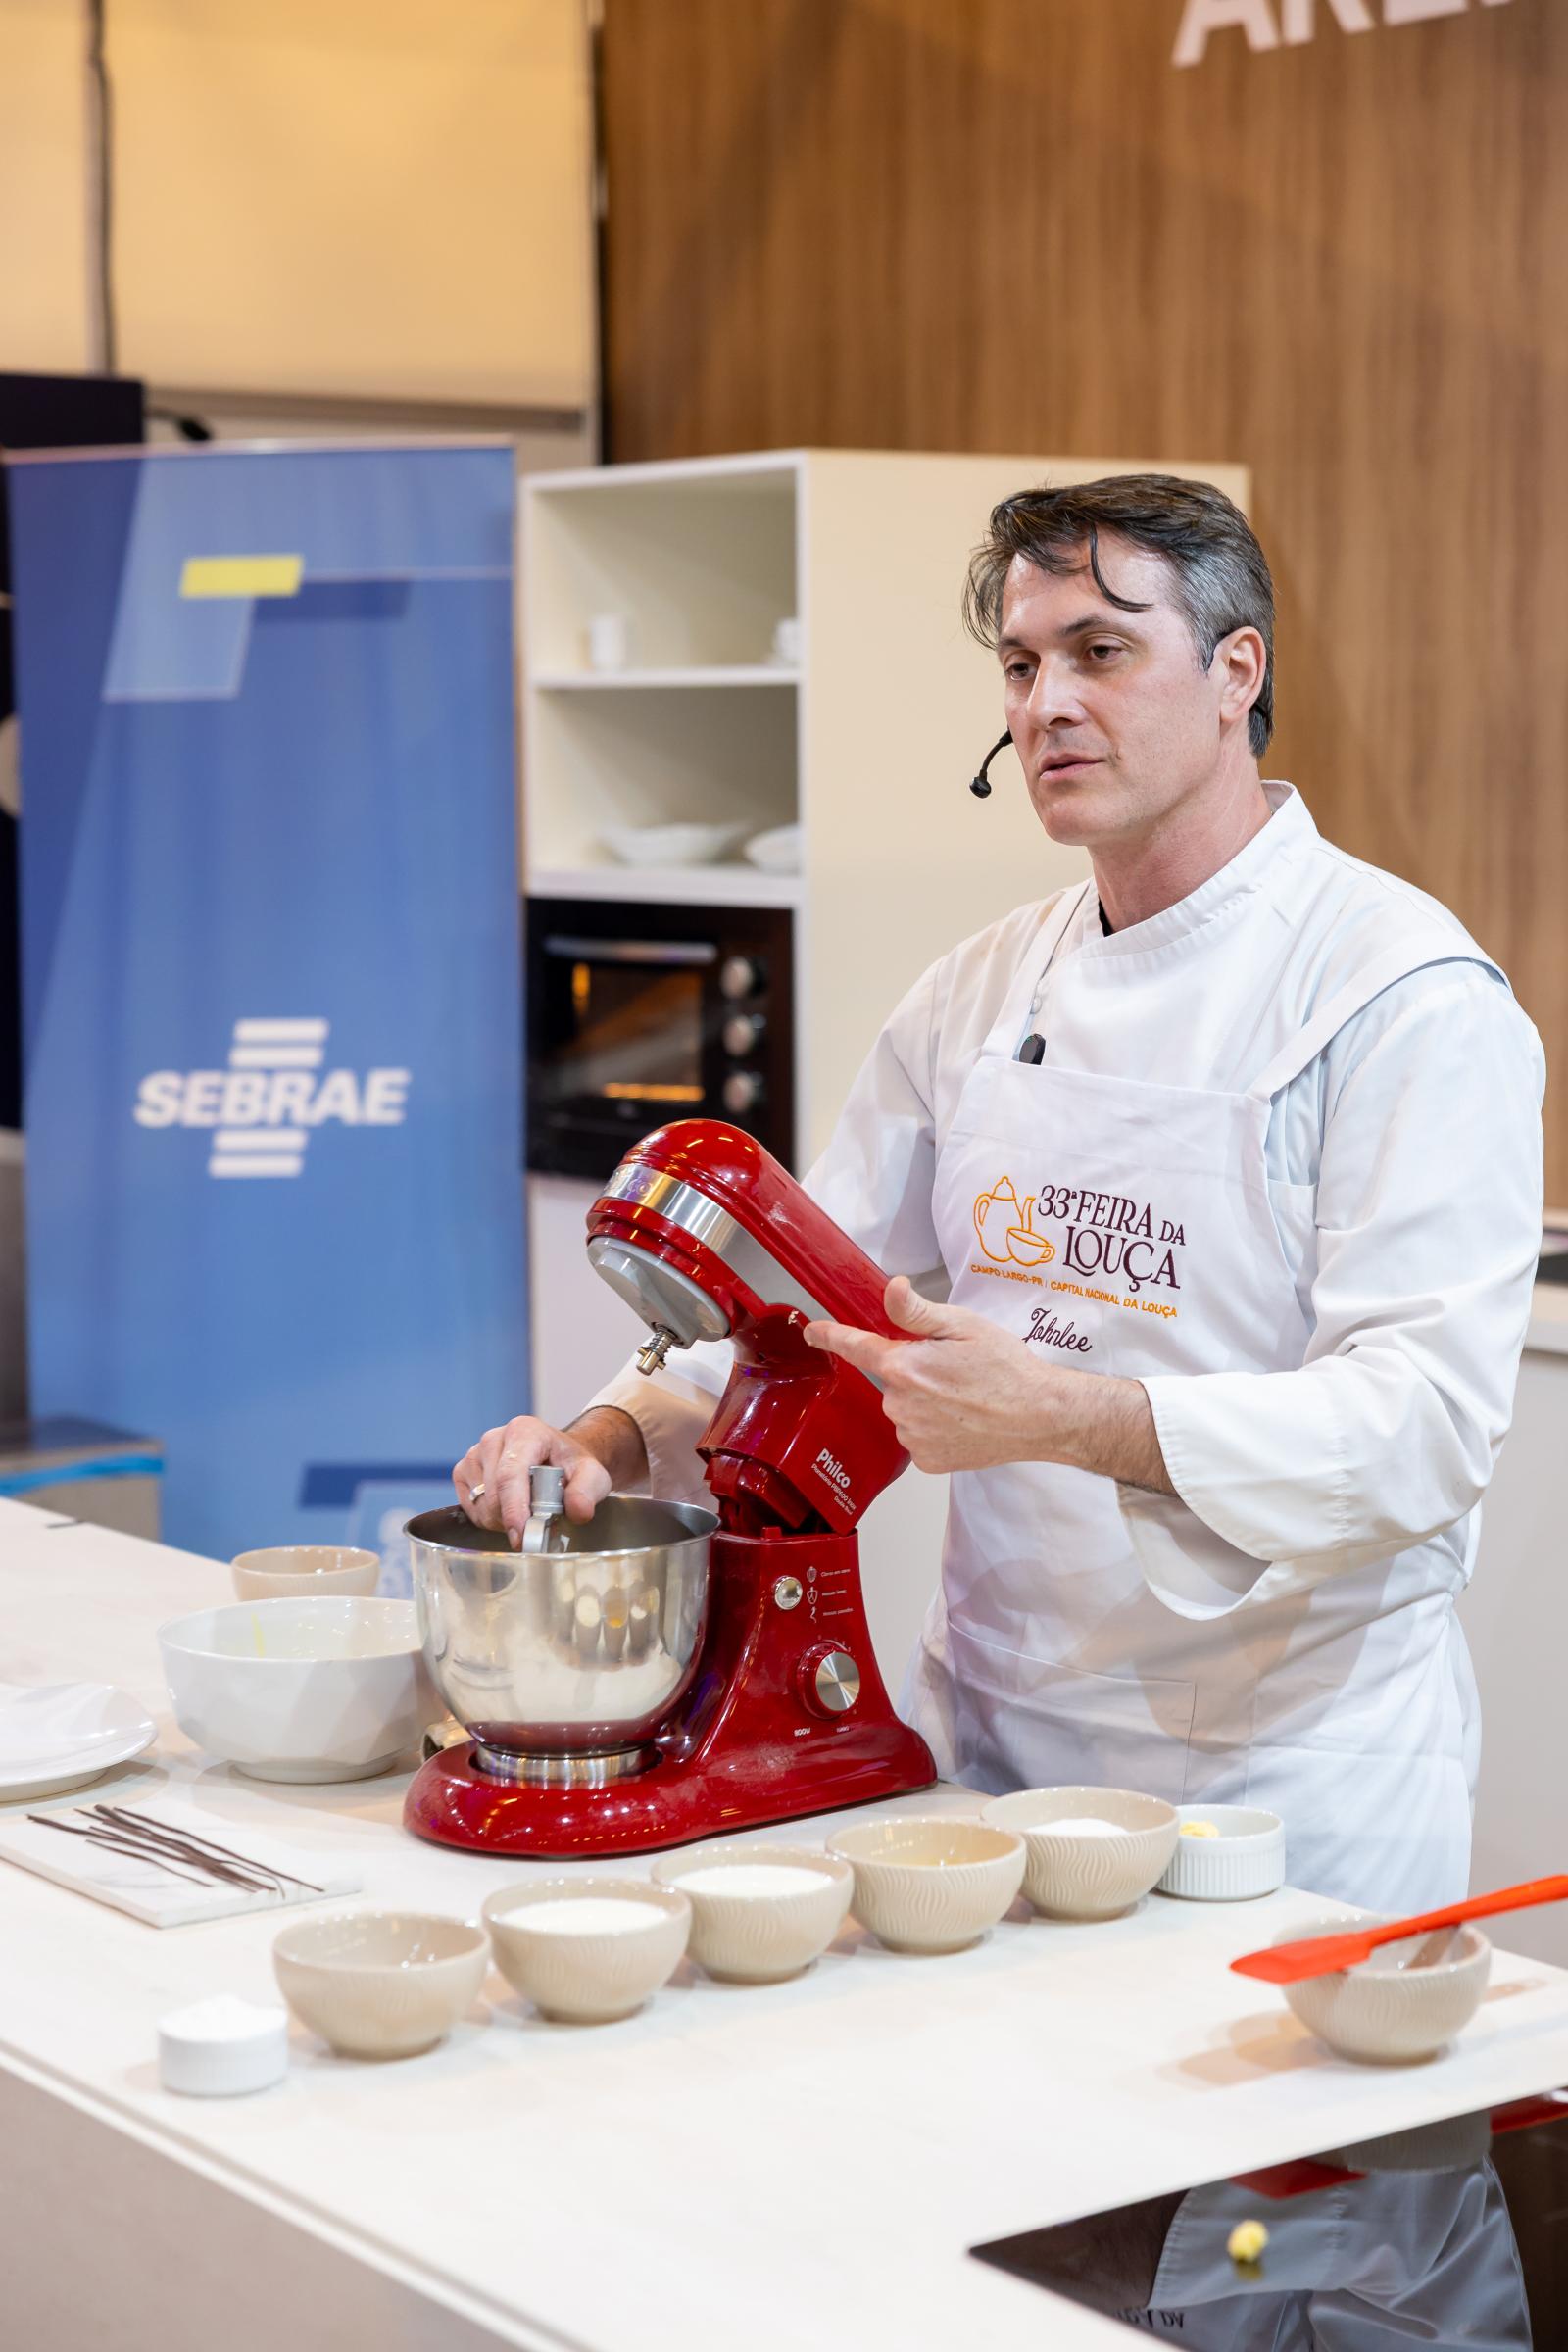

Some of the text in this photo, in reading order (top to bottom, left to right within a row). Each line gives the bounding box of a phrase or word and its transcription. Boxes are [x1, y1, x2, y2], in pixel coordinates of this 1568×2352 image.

[134, 1068, 412, 1127] SEBRAE
[1074, 1190, 1153, 1239] FEIRA
[1159, 1220, 1186, 1246] DA
[1062, 1225, 1181, 1292] LOUÇA
[970, 1264, 1000, 1276] CAMPO
[1050, 1280, 1083, 1296] CAPITAL
[1085, 1289, 1119, 1304] NACIONAL
[1123, 1298, 1138, 1309] DA
[1142, 1301, 1177, 1318] LOUÇA
[1021, 1308, 1093, 1352] Johnlee
[816, 1447, 851, 1488] Philco
